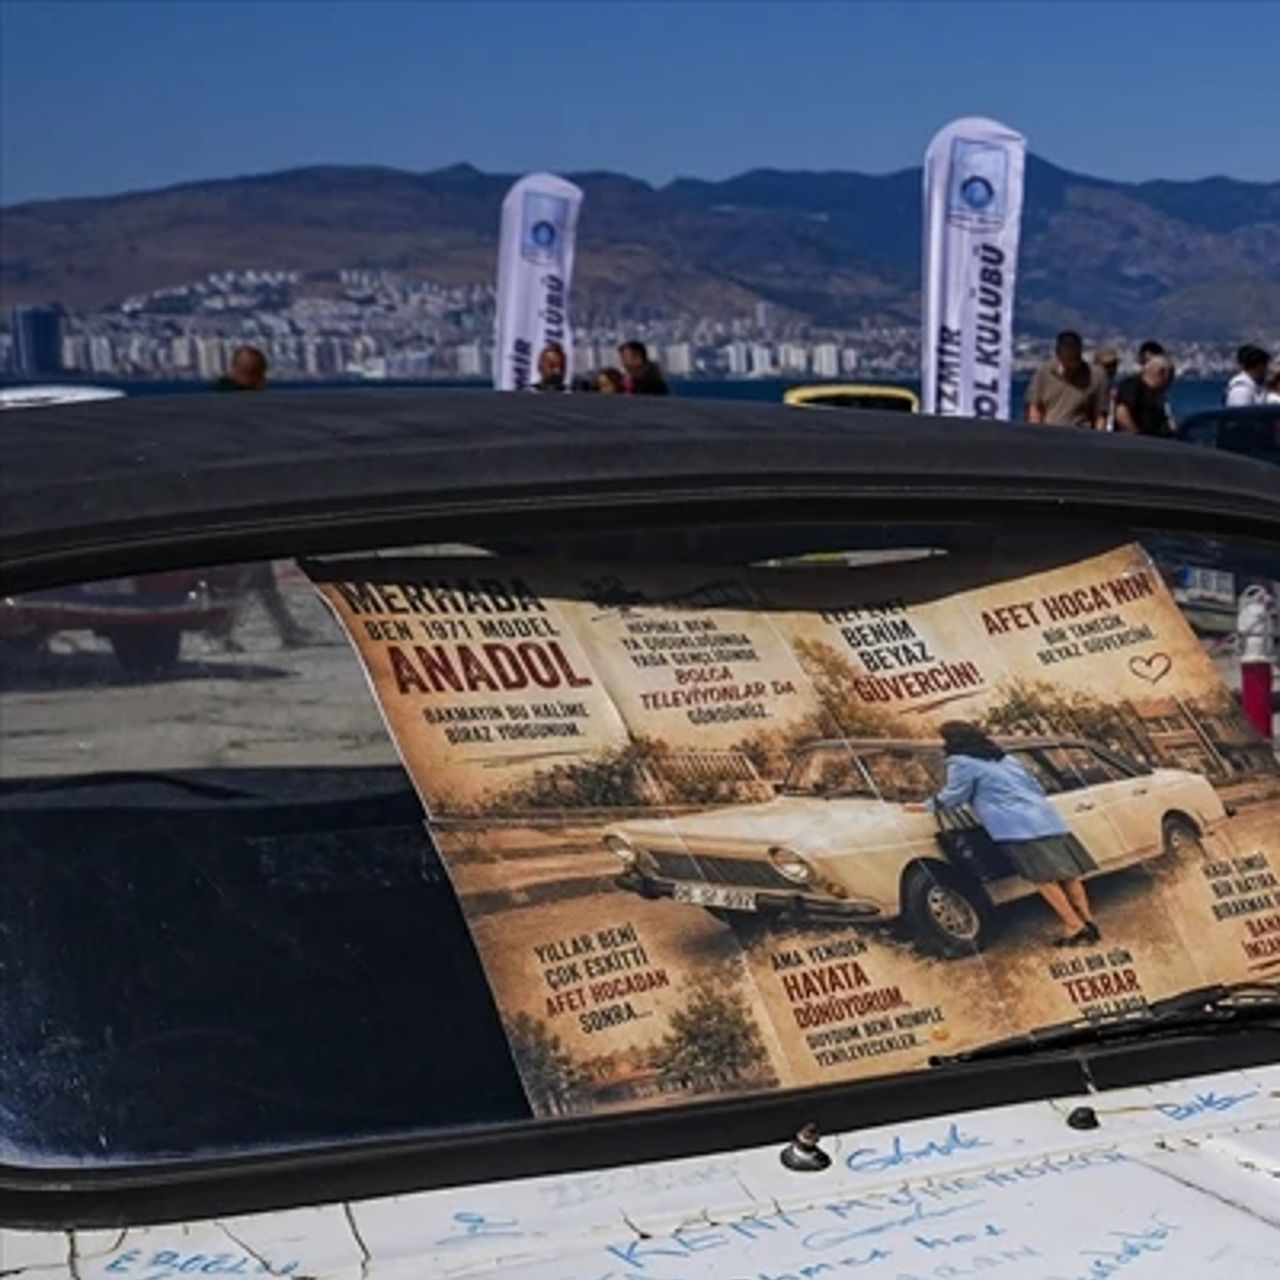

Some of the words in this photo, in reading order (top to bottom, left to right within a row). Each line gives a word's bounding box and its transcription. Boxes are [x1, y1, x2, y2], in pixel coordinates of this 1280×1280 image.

[968, 243, 1006, 369] KULÜBÜ
[981, 602, 1043, 637] AFET
[1042, 571, 1156, 623] HOCA'NIN
[364, 620, 414, 641] BEN
[421, 619, 473, 641] 1971
[478, 616, 561, 639] MODEL
[841, 619, 917, 649] BENİM
[387, 640, 593, 696] ANADOL
[858, 641, 935, 673] BEYAZ
[853, 661, 985, 703] GÜVERCİN!
[534, 933, 596, 965] YILLAR
[597, 921, 639, 951] BENİ
[544, 960, 583, 992] ÇOK
[546, 994, 588, 1018] AFET
[591, 968, 670, 1003] HOCADAN
[782, 961, 871, 1003] HAYATA
[1062, 968, 1142, 1005] TEKRAR
